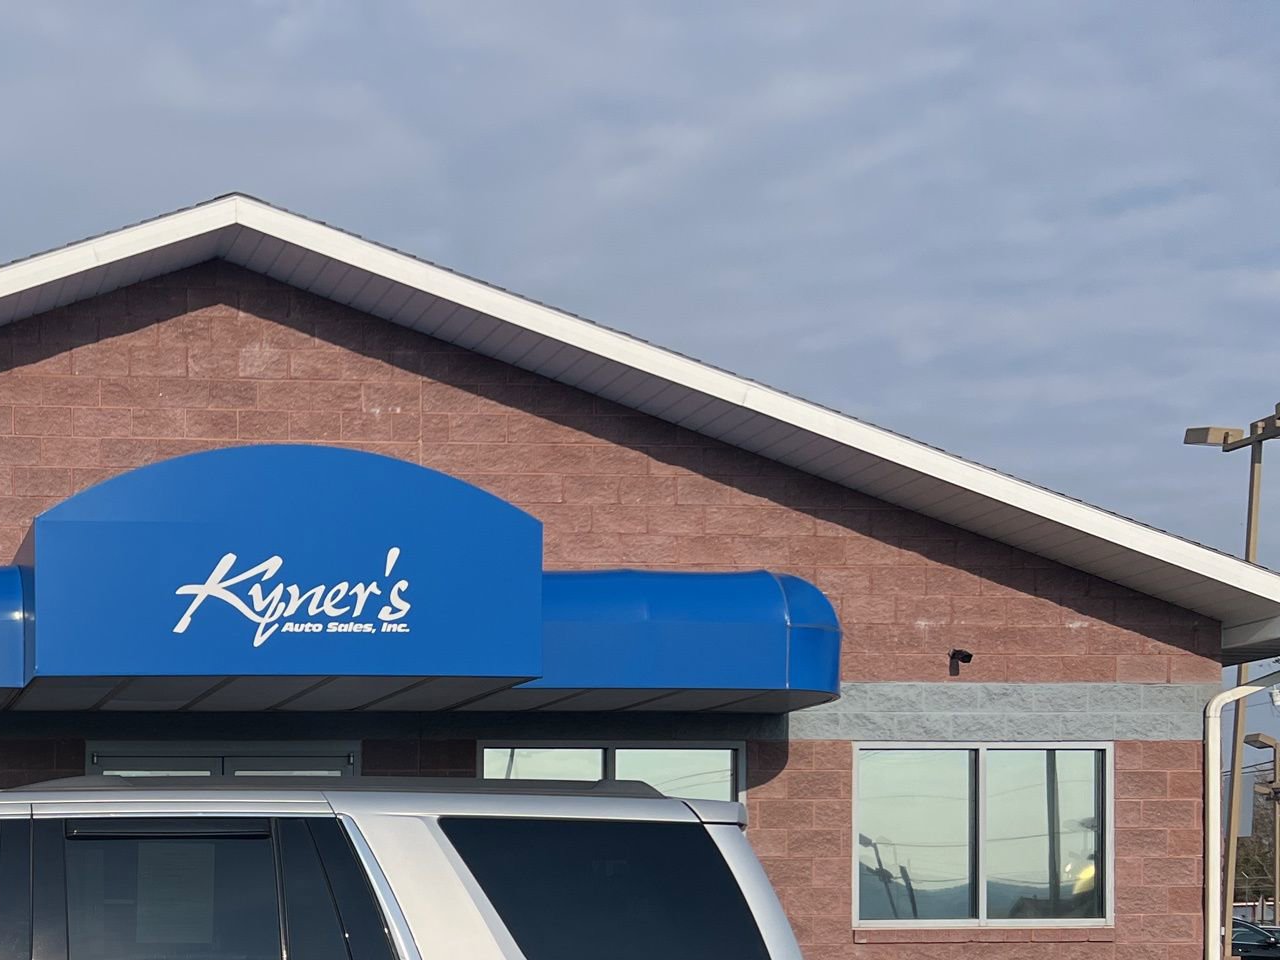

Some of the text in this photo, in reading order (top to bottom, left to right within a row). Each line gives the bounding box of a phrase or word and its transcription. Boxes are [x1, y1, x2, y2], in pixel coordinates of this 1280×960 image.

[172, 547, 411, 648] Kyner's
[280, 622, 410, 634] Auto Sales, Inc.
